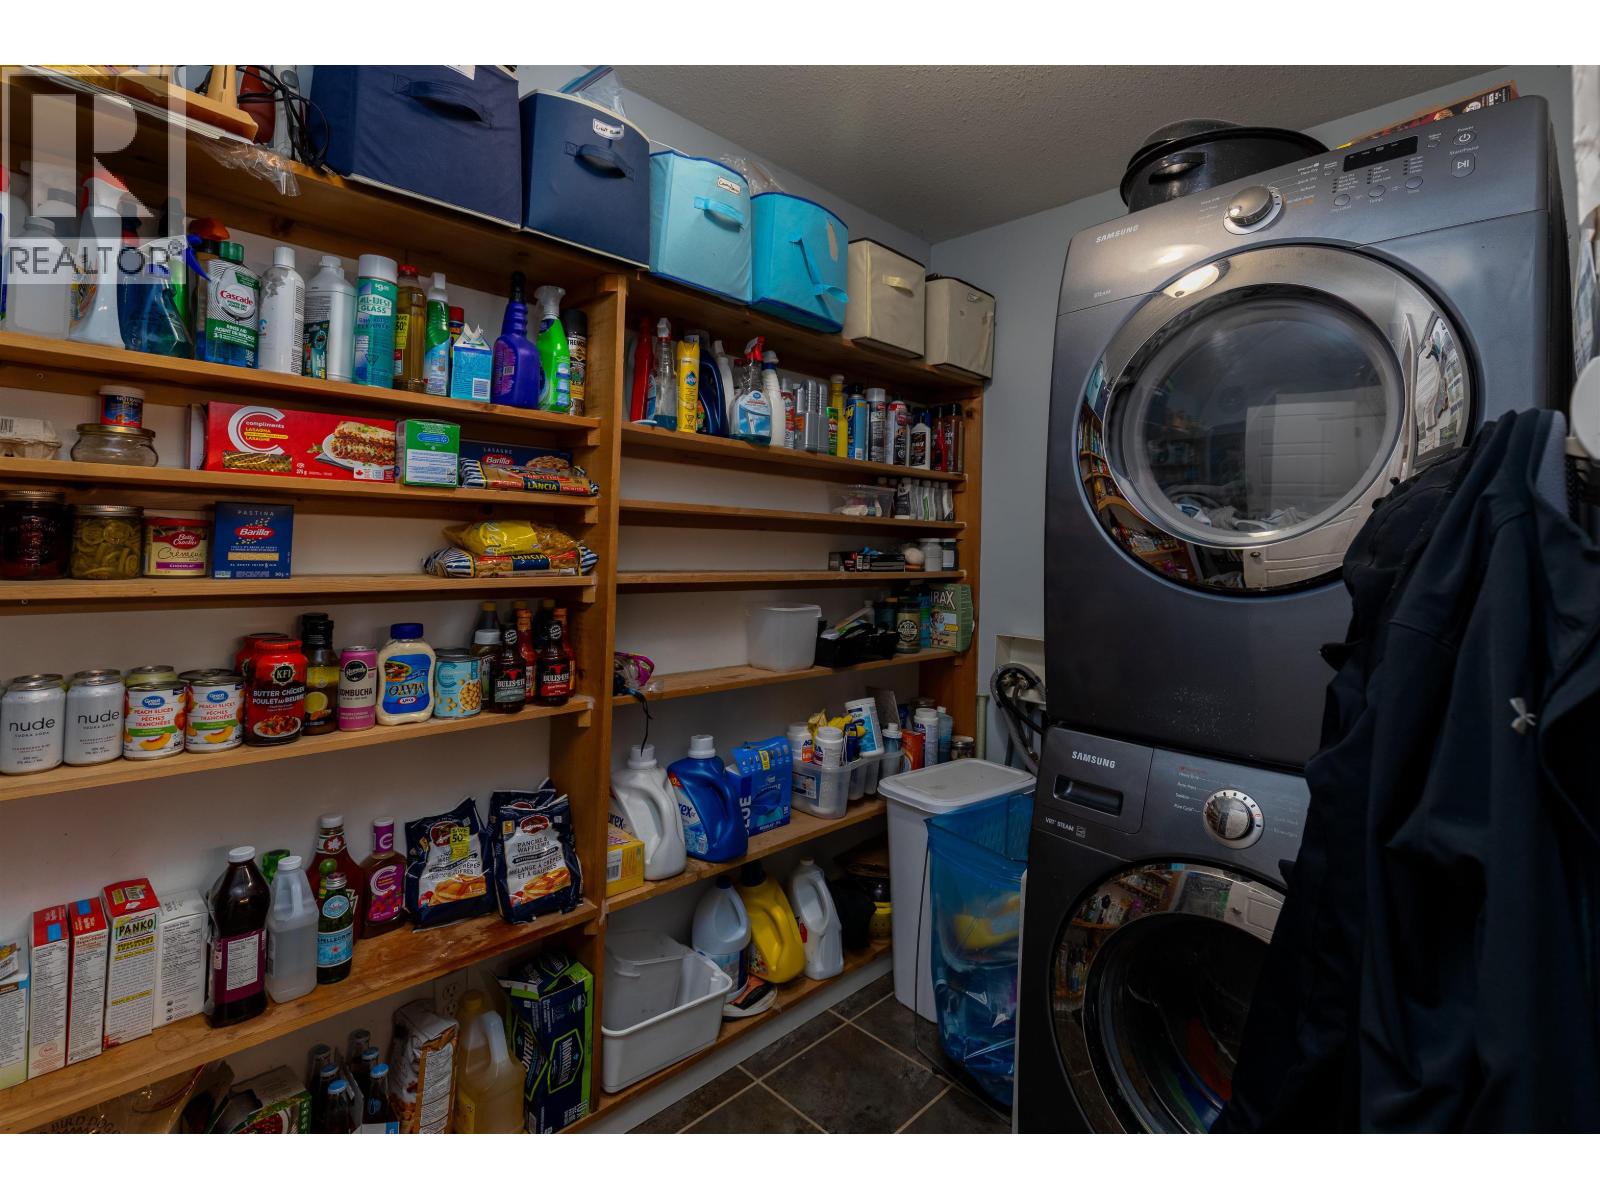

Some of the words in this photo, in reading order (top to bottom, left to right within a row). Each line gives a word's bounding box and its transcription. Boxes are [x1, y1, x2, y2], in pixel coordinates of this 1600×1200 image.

[1095, 224, 1139, 243] SAMSUNG
[219, 290, 254, 305] Cascade
[361, 304, 386, 314] GLASS
[246, 420, 285, 429] compliments
[485, 456, 512, 466] Barilla
[527, 481, 558, 492] LANCIA
[239, 528, 272, 537] Barilla
[276, 669, 291, 679] KFI
[144, 698, 161, 706] Great
[78, 710, 120, 724] nude
[9, 717, 56, 733] nude
[1071, 750, 1116, 769] SAMSUNG
[608, 811, 625, 830] urex
[1057, 821, 1075, 832] STEAM
[119, 918, 154, 936] PANKO
